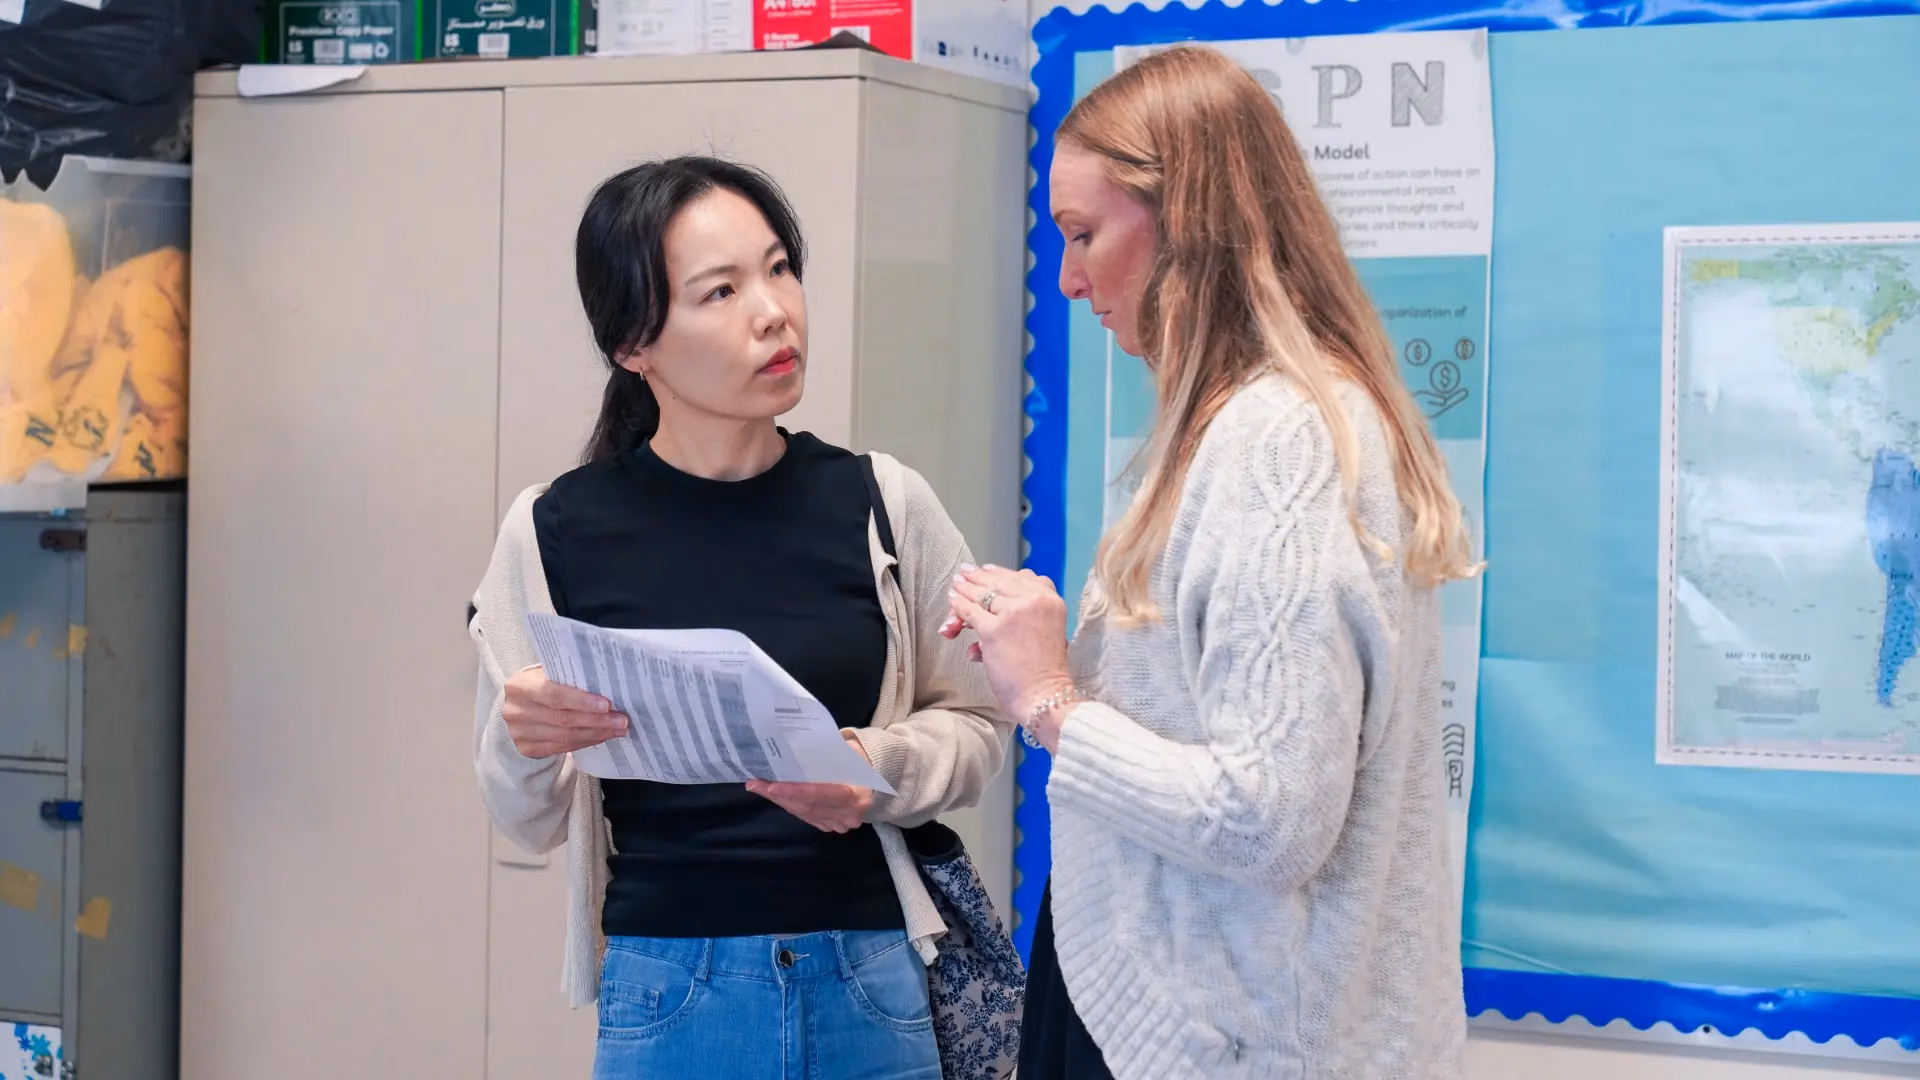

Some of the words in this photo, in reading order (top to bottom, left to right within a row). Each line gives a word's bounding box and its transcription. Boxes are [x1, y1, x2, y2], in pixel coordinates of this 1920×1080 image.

[1314, 142, 1371, 161] Model
[1358, 169, 1370, 180] of
[1371, 168, 1408, 180] action
[1410, 169, 1432, 179] can
[1434, 166, 1462, 178] have
[1466, 168, 1480, 178] an
[1386, 202, 1438, 216] thoughts
[1442, 201, 1464, 212] and
[1372, 220, 1395, 231] and
[1397, 219, 1426, 230] think
[1428, 218, 1479, 232] critically
[1454, 304, 1468, 318] of
[1725, 651, 1744, 660] MAP
[1747, 651, 1757, 660] OF
[1760, 651, 1777, 661] THE
[1779, 652, 1811, 662] WORLD
